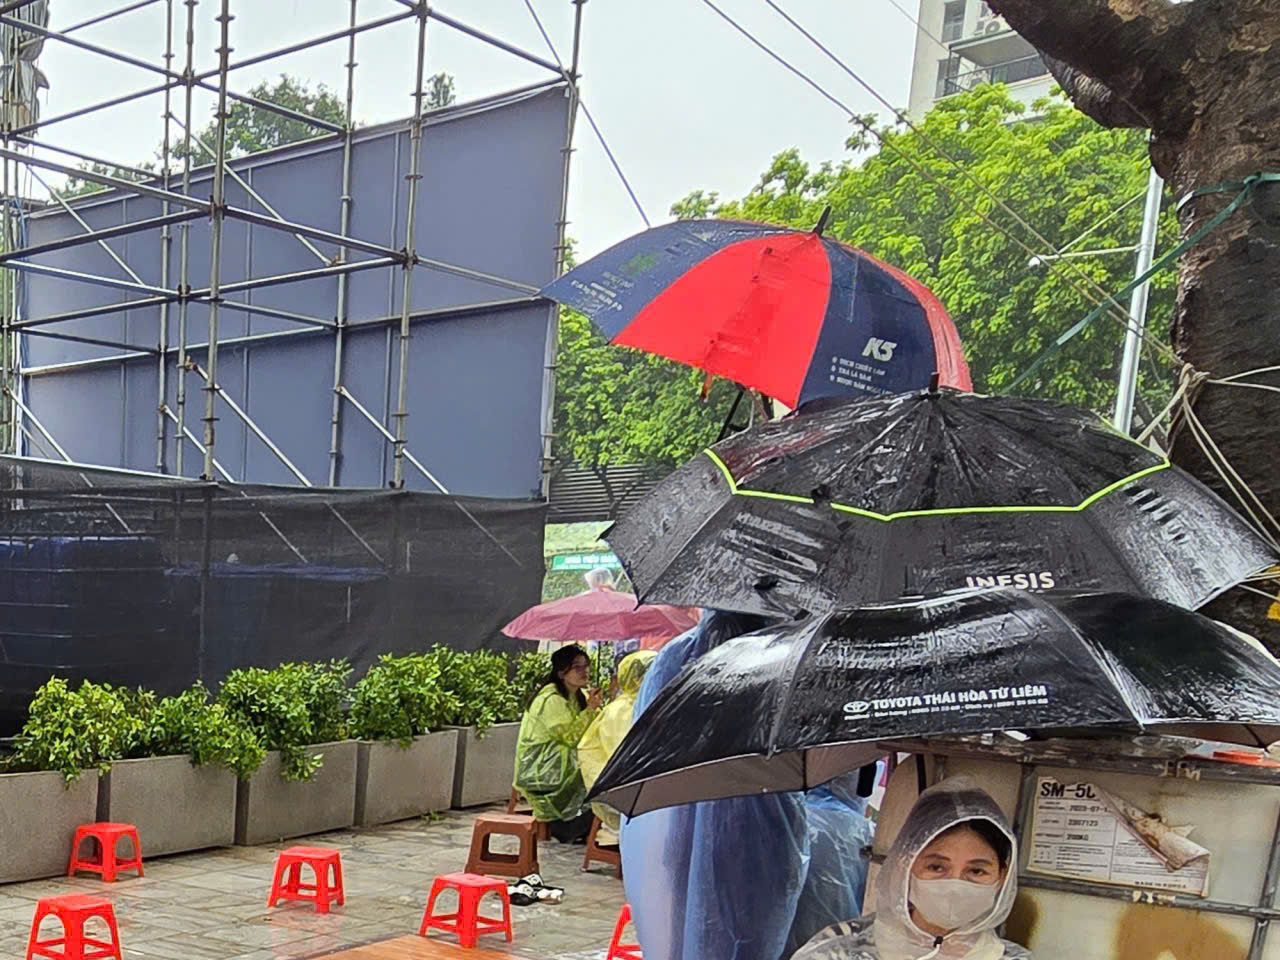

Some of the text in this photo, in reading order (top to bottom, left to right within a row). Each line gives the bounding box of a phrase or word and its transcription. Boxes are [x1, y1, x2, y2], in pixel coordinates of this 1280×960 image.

[862, 337, 897, 361] K5
[966, 571, 1055, 590] INESIS
[871, 696, 922, 709] TOYOTA
[923, 691, 956, 705] THÁI
[958, 689, 988, 702] HÒA
[1011, 684, 1047, 698] LIÊM
